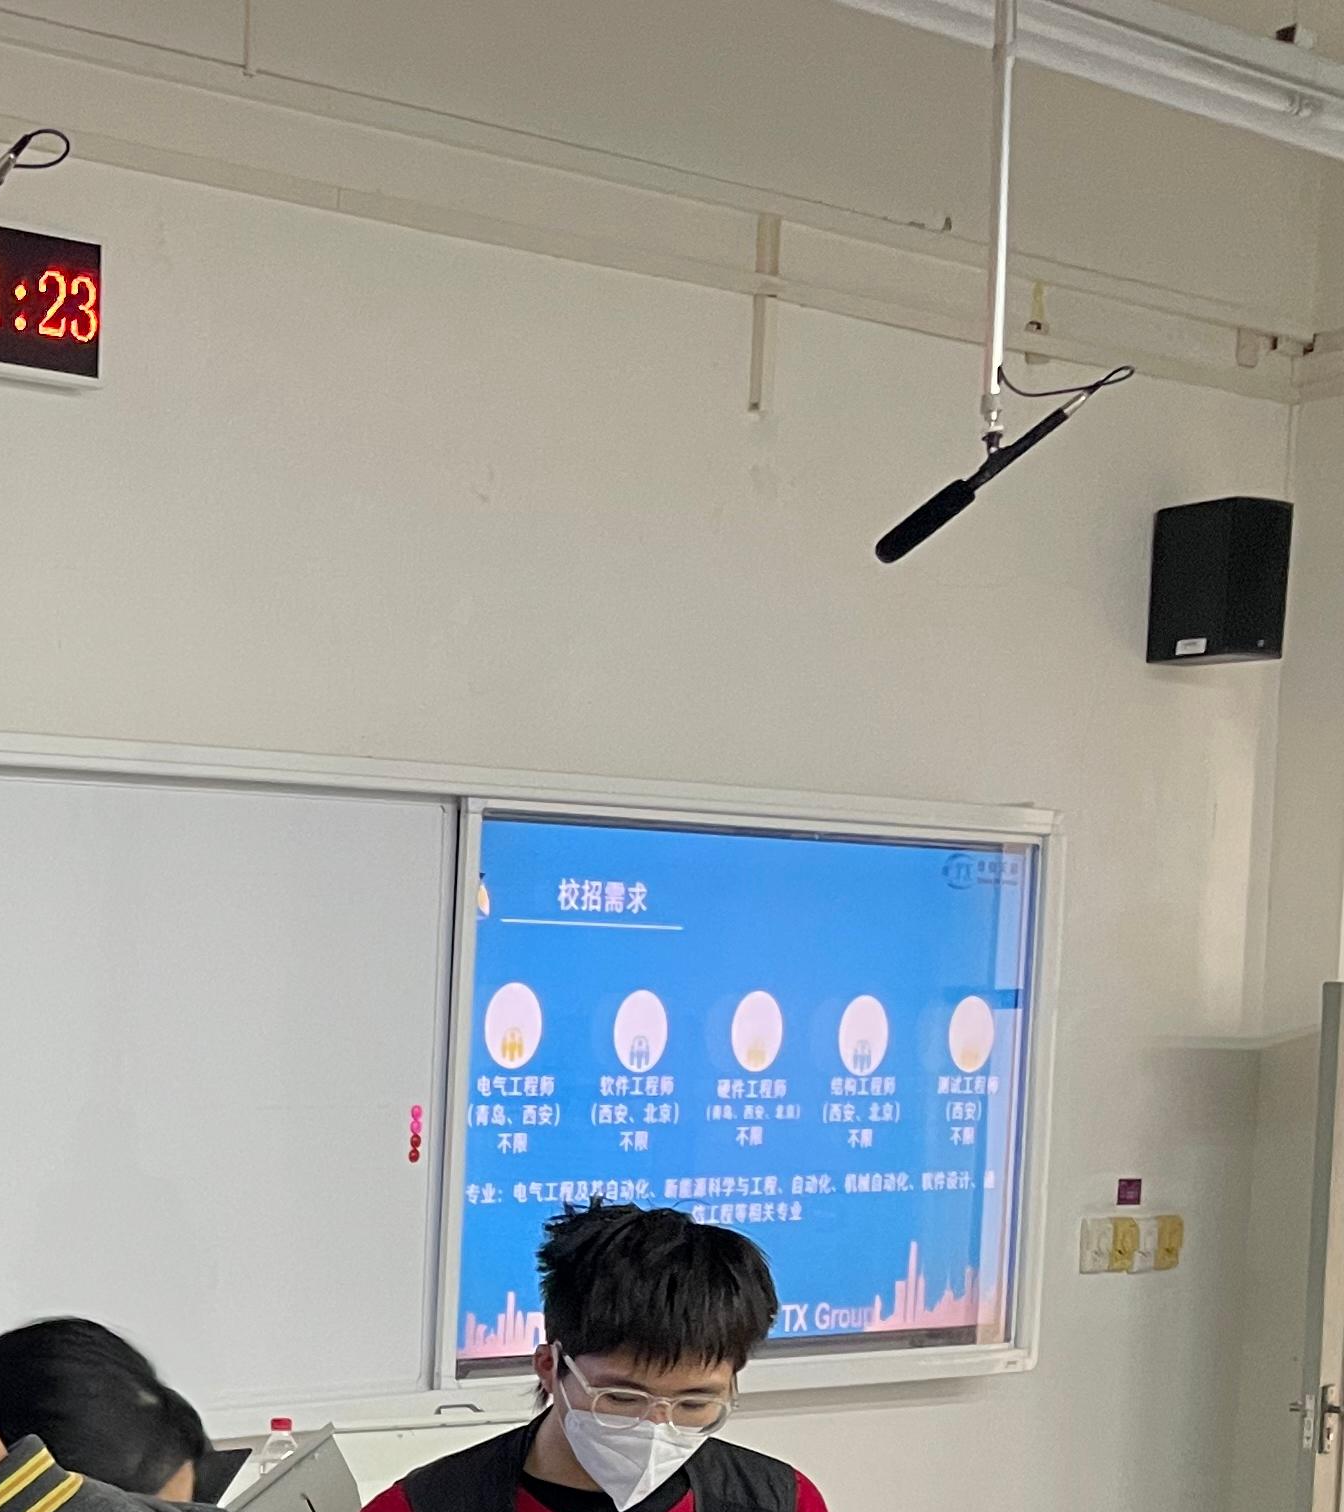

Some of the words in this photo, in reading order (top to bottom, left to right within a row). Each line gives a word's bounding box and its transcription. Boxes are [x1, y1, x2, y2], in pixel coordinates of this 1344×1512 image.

[558, 878, 648, 914] 校招需求
[476, 1075, 555, 1097] 电气工程师
[599, 1075, 675, 1097] 软件工程师
[781, 1303, 809, 1333] TX
